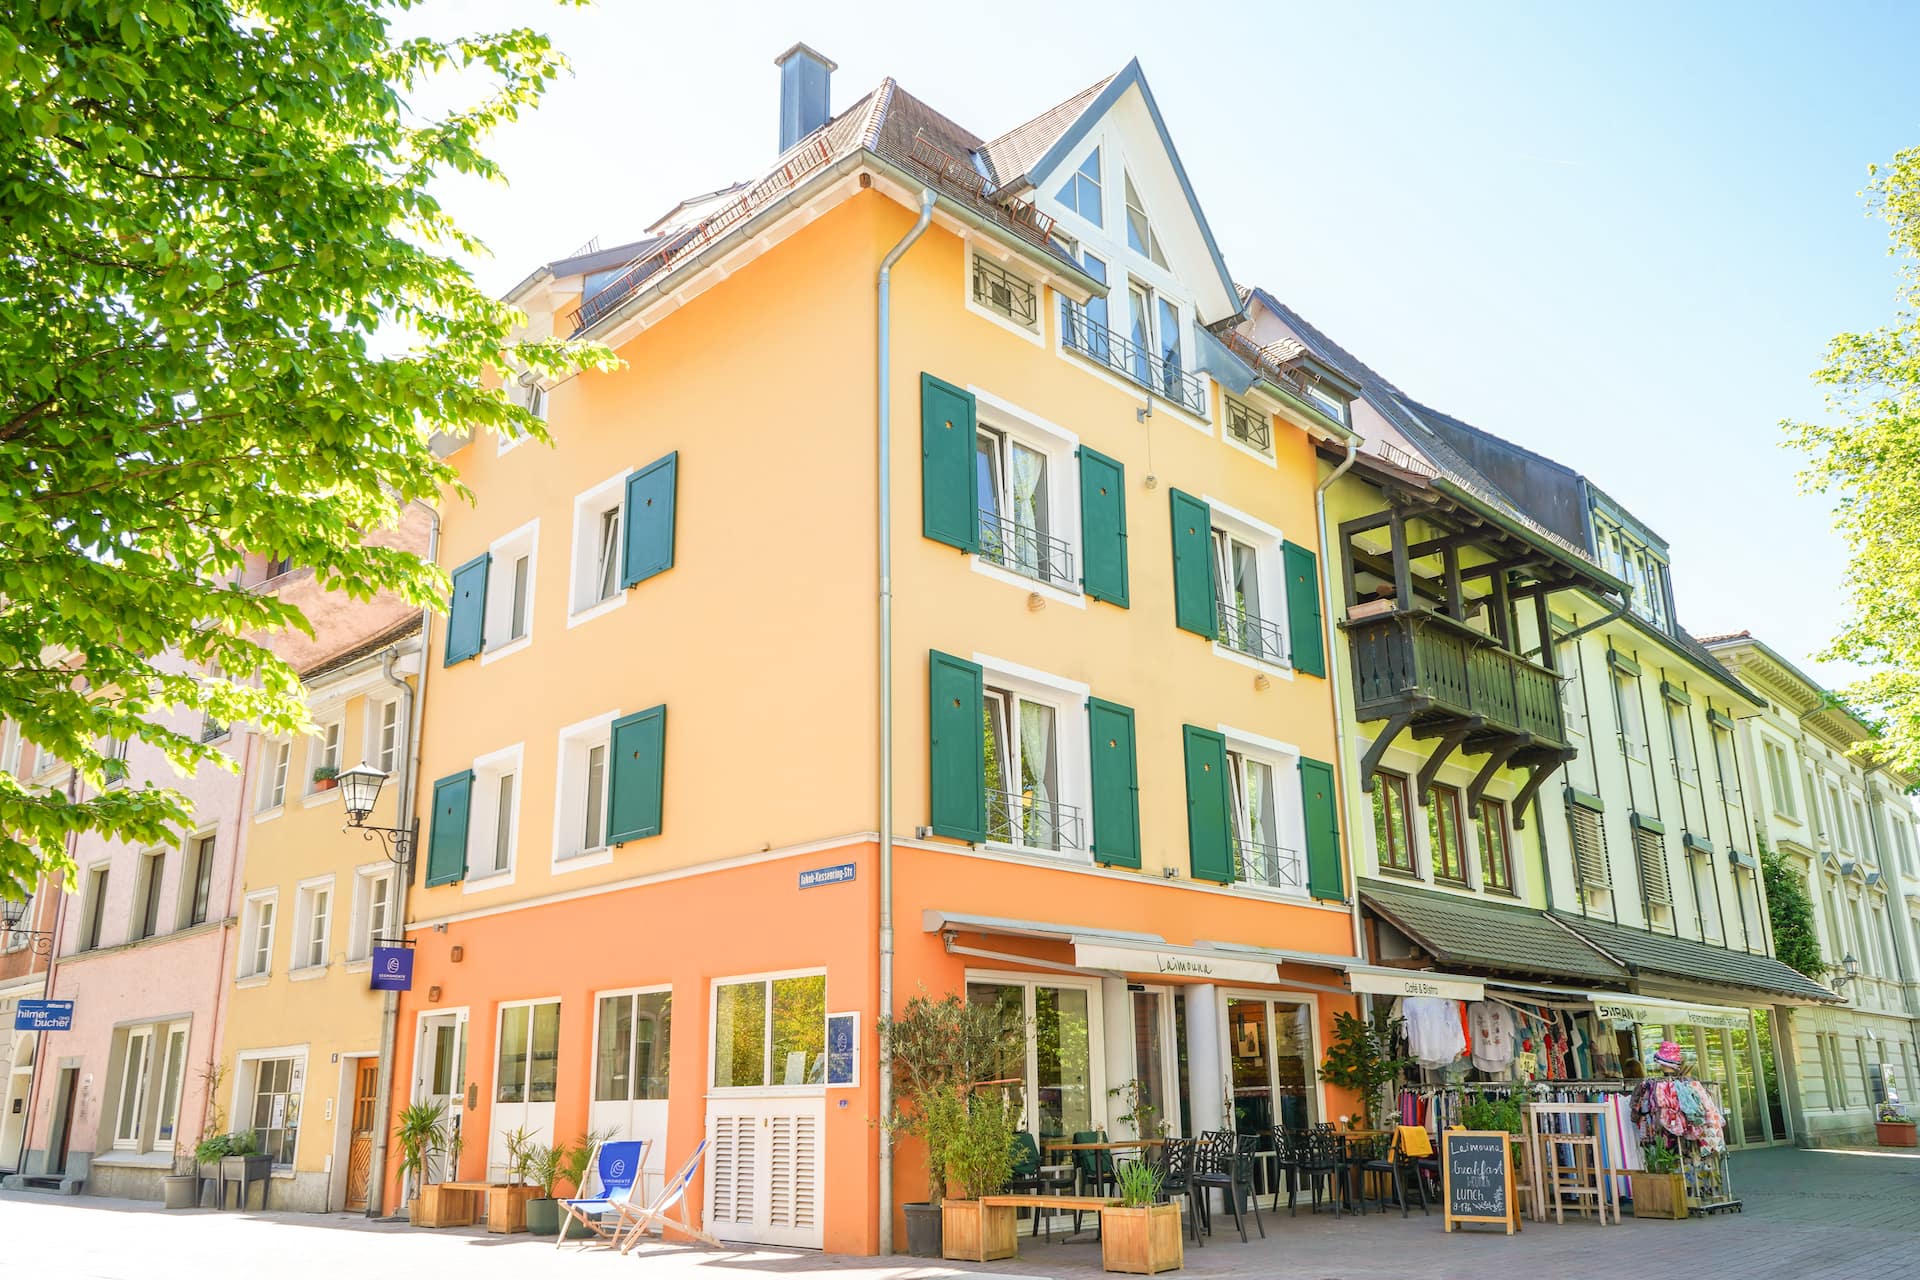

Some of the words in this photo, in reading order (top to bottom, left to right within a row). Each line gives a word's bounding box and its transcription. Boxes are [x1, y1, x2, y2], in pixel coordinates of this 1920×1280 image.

[1157, 951, 1212, 974] Laimouna
[17, 1009, 49, 1019] hilmer
[33, 1018, 69, 1027] bucher
